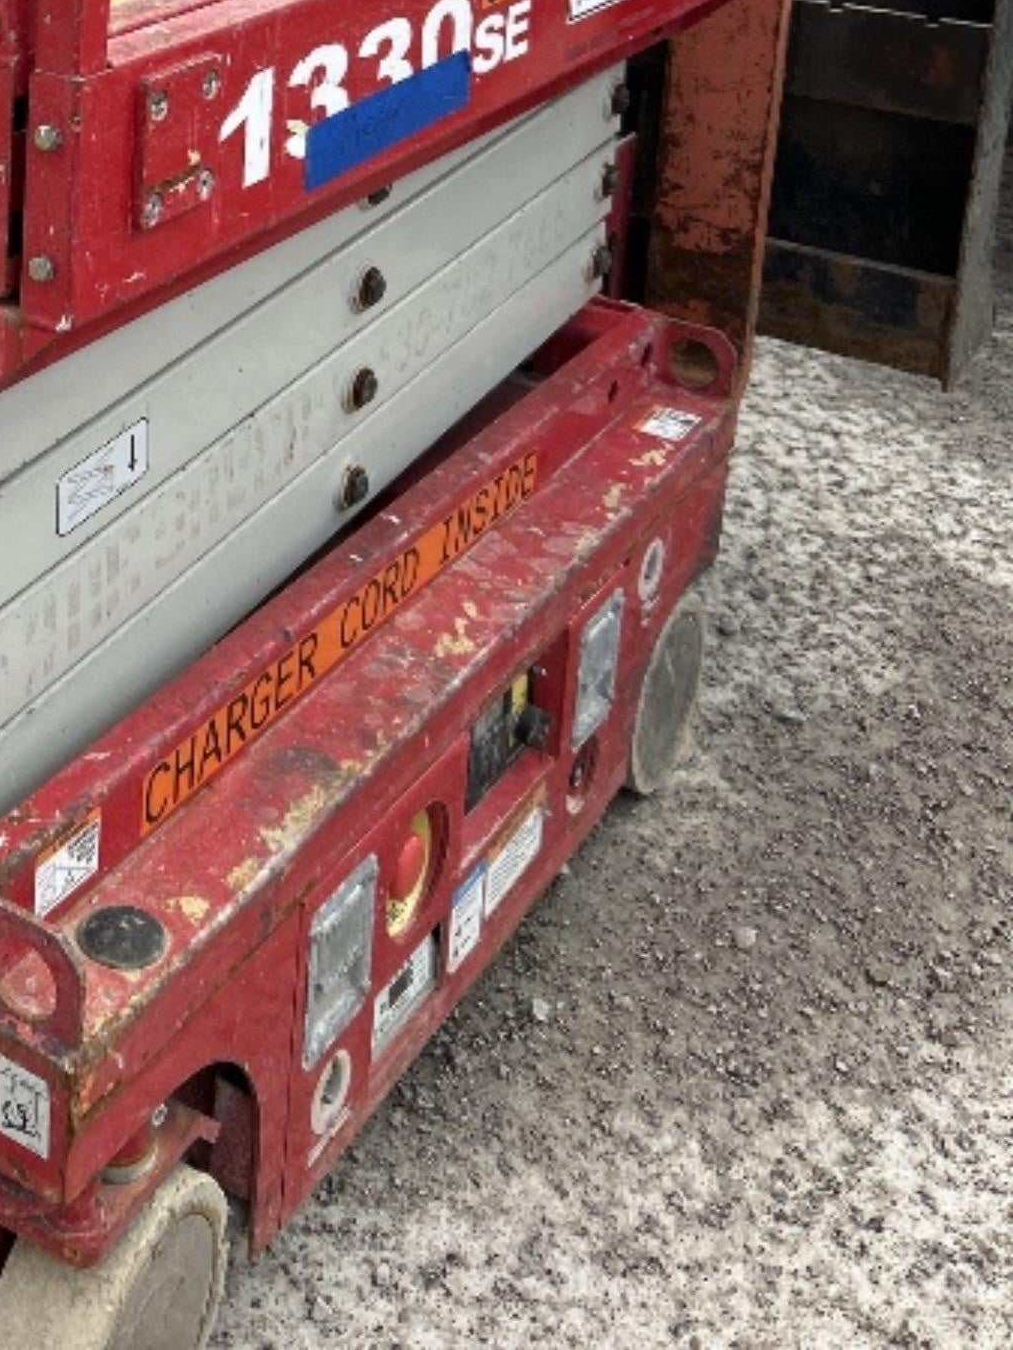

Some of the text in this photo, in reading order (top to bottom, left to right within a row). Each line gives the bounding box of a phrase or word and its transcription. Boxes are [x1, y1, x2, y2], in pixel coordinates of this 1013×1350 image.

[143, 631, 319, 826] CHARGER
[337, 545, 422, 651] CORD
[438, 449, 539, 568] INSIDE
